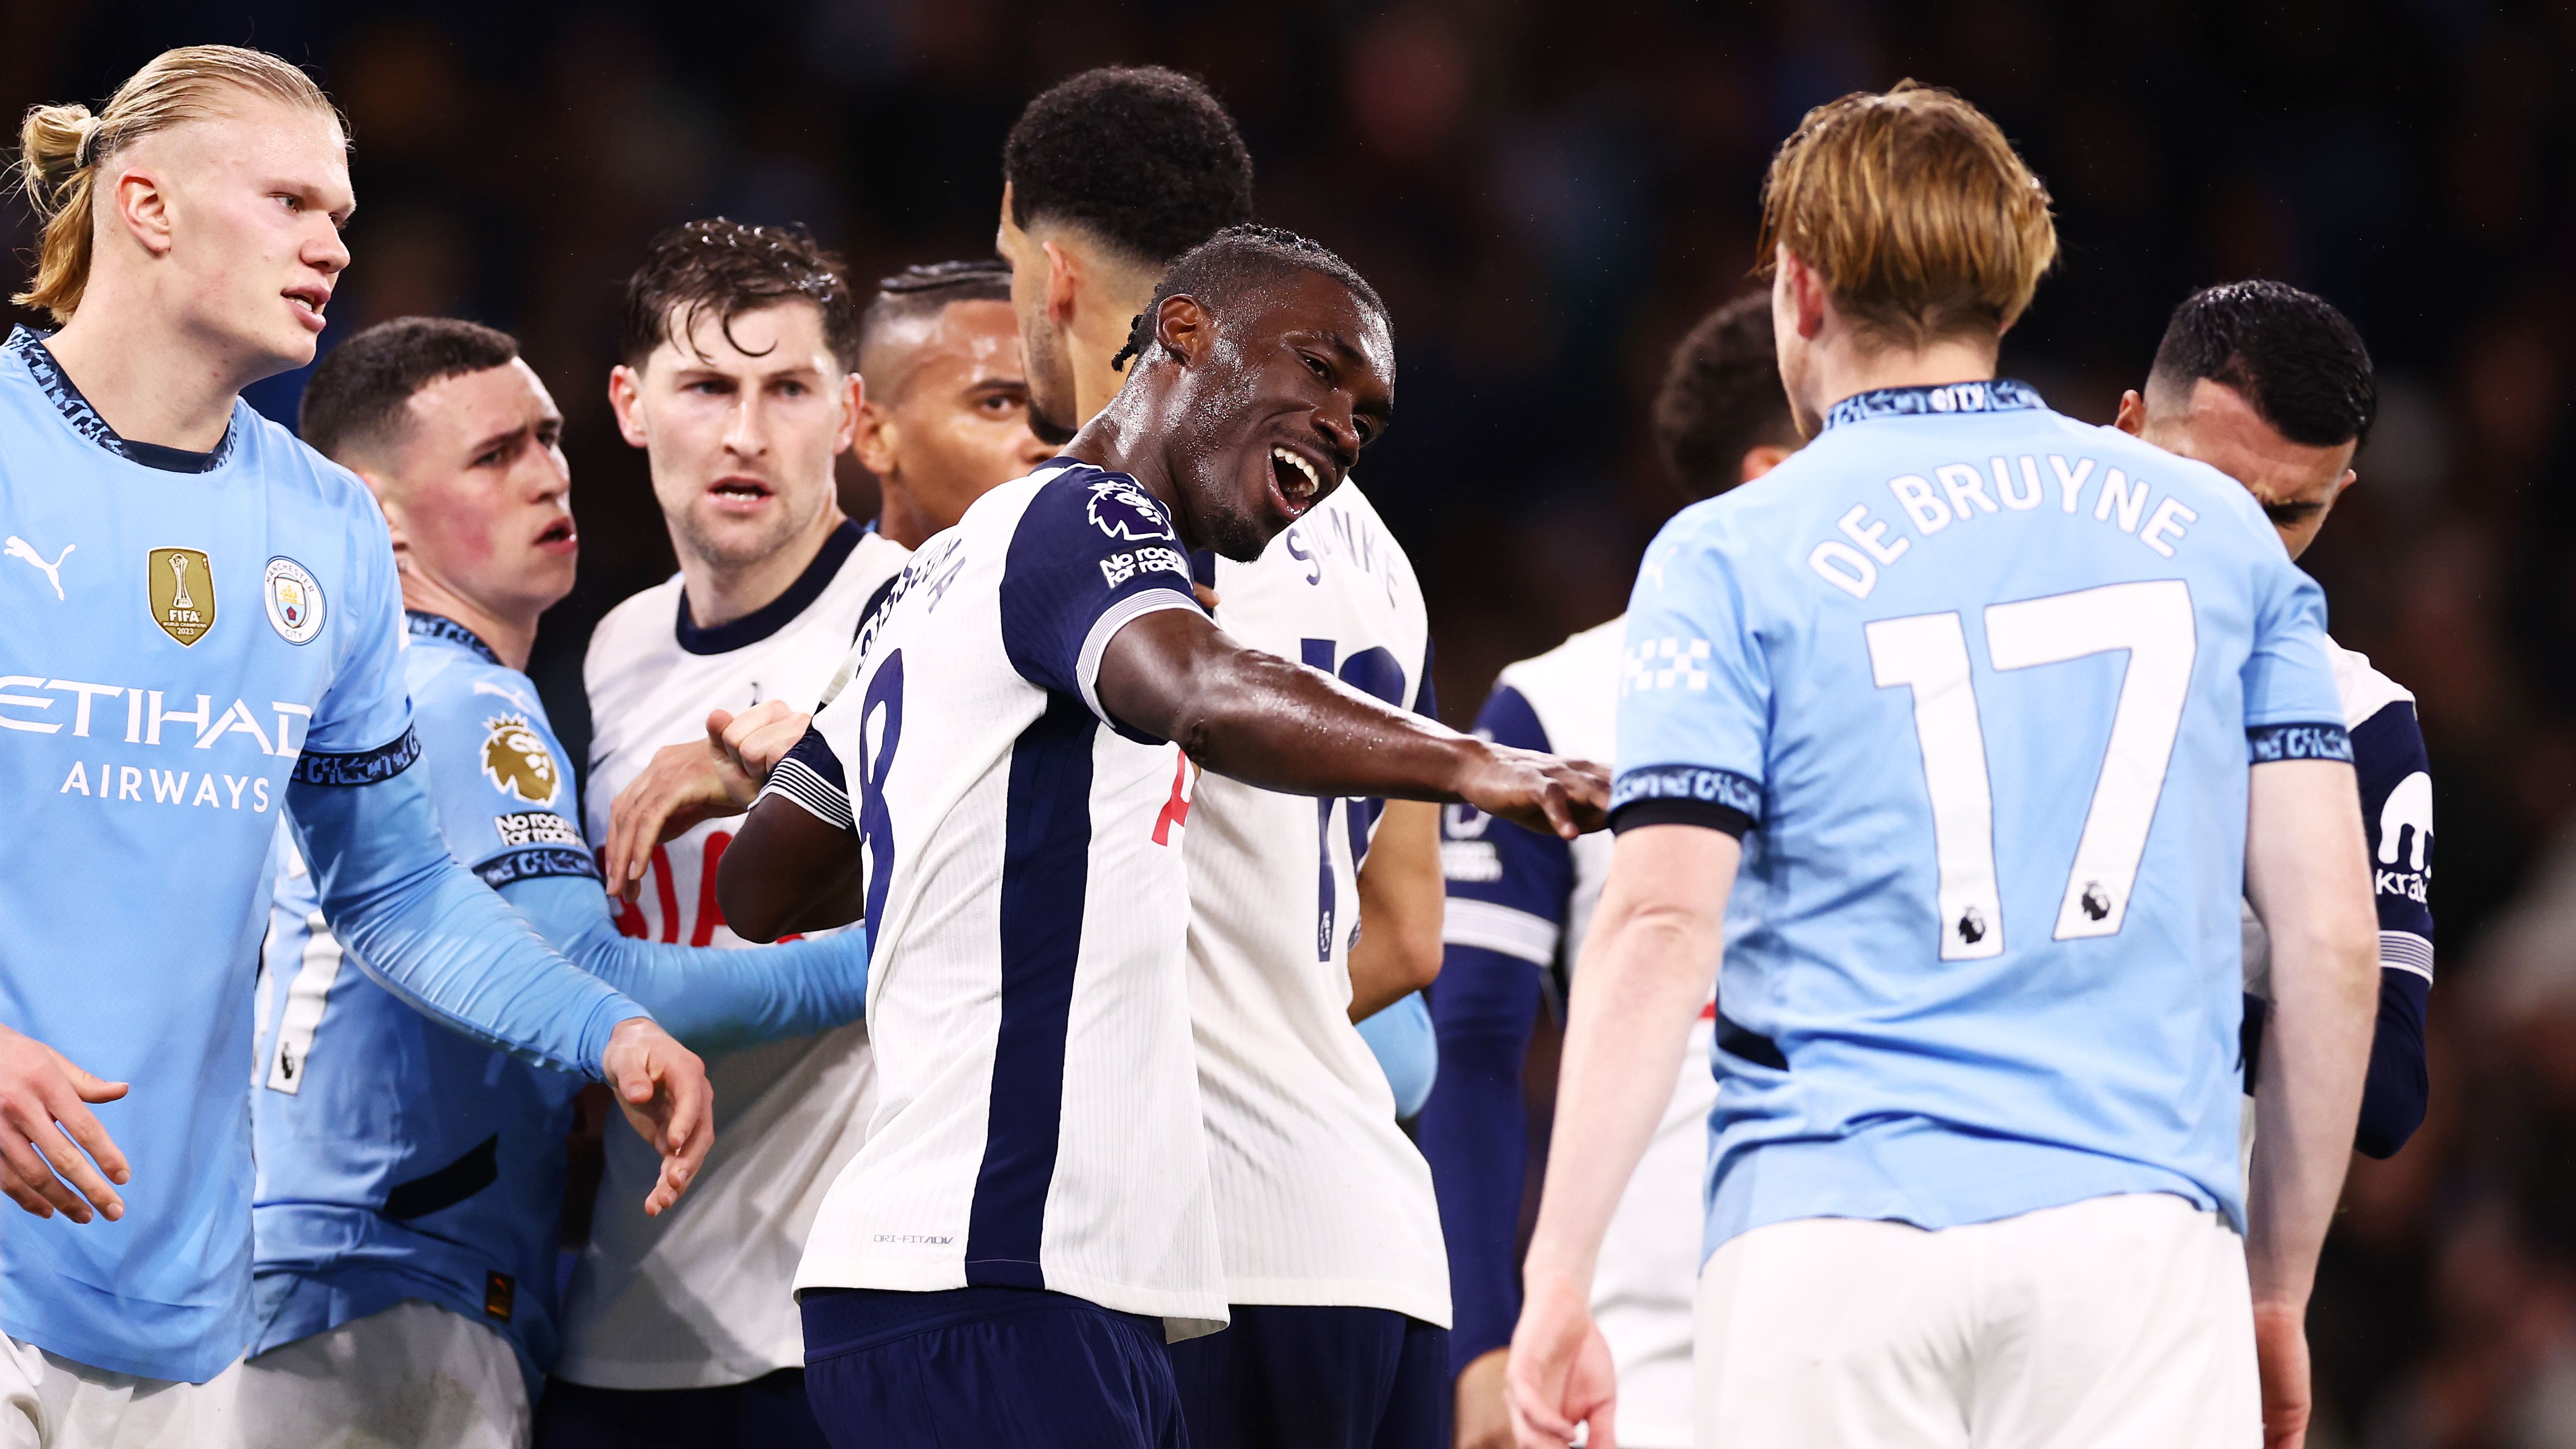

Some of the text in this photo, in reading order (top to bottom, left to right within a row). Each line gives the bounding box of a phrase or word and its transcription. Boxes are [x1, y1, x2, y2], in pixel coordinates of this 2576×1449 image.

[1931, 387, 1985, 411] CITY
[1808, 455, 2199, 599] DE BRUYNE
[1100, 554, 1134, 576] No
[1106, 564, 1136, 589] for
[267, 563, 314, 593] MANCHESTER
[285, 629, 303, 639] CITY
[0, 675, 312, 758] ETIHAD
[1864, 578, 2197, 962] 17
[60, 761, 269, 813] AIRWAYS
[494, 813, 529, 833] No
[500, 828, 530, 847] for
